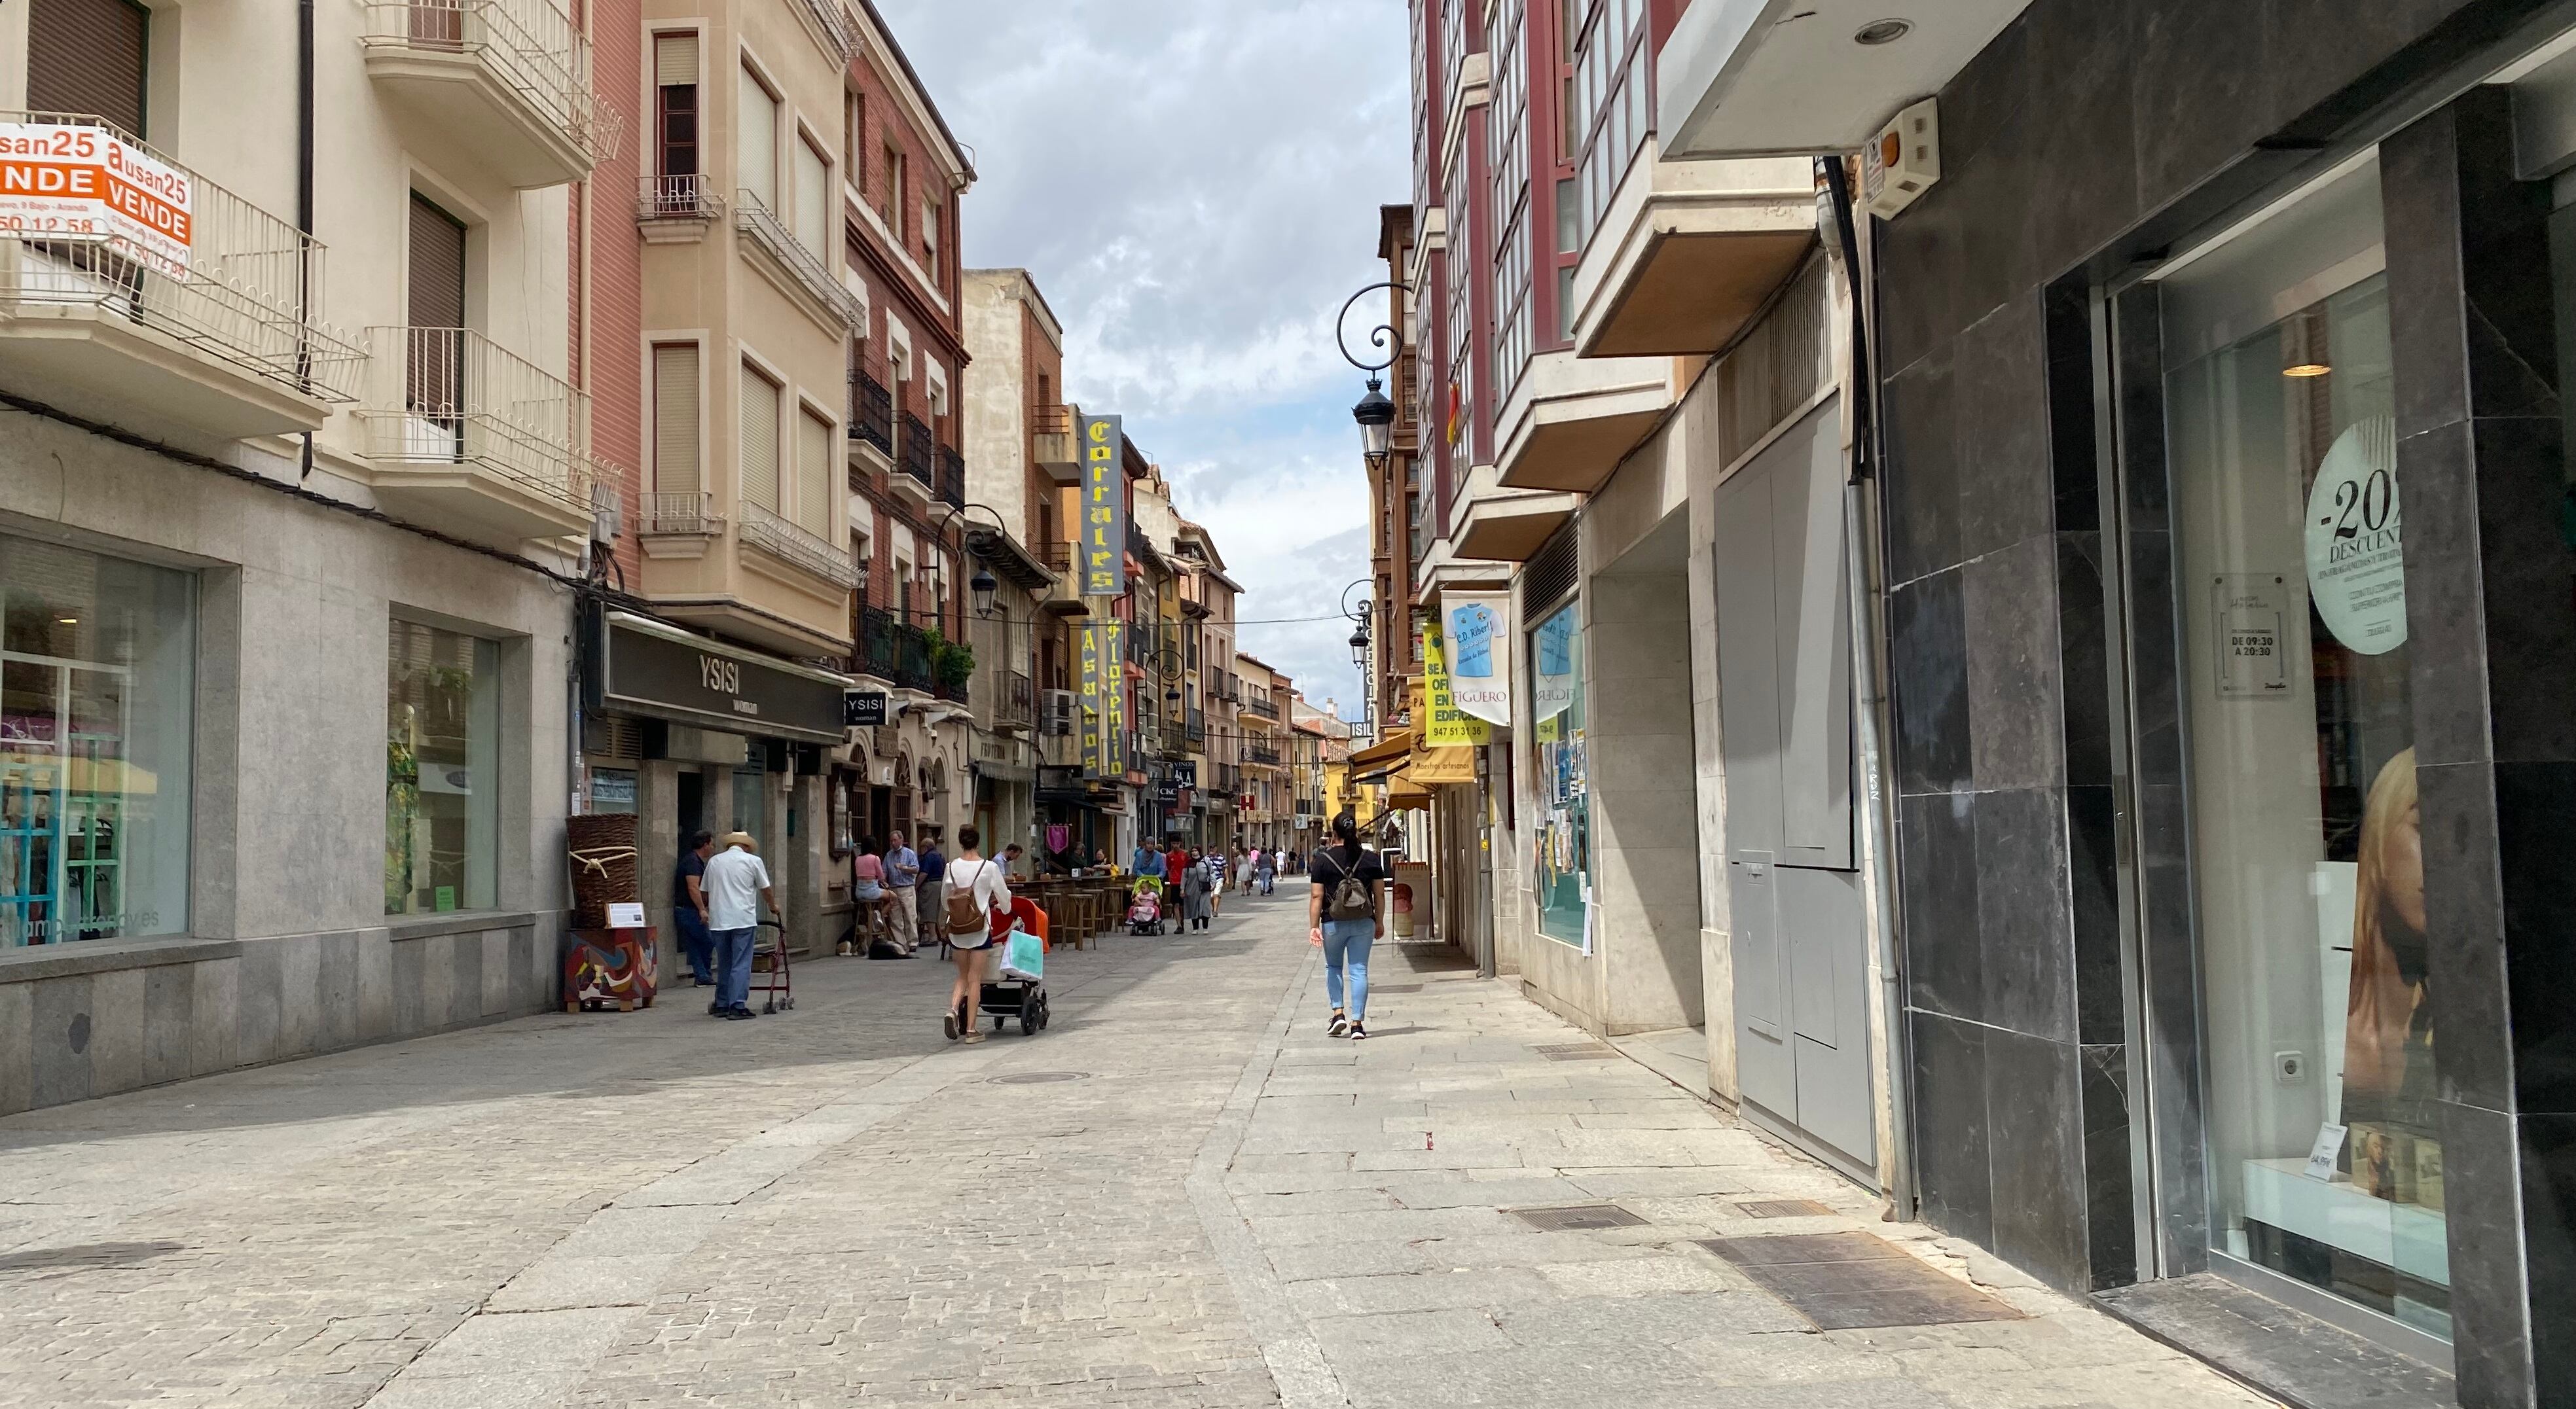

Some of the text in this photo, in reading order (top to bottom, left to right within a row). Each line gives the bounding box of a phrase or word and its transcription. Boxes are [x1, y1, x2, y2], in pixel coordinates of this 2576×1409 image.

[107, 142, 186, 204] ausan25
[109, 179, 187, 238] VENDE
[1089, 421, 1113, 587] Corrales
[2321, 469, 2401, 542] -20
[2232, 637, 2273, 645] DE 09:30
[2235, 647, 2271, 656] A 20:30
[699, 654, 739, 694] YSISI
[1428, 663, 1440, 675] SE
[1083, 629, 1098, 769] Asados
[1435, 694, 1449, 706] EN
[1453, 691, 1506, 703] FIGUERO
[733, 699, 757, 715] woman
[849, 699, 883, 710] YSISI
[1352, 722, 1373, 736] ISIL
[1449, 727, 1458, 736] 51
[1461, 727, 1469, 736] 31
[1472, 726, 1481, 736] 36
